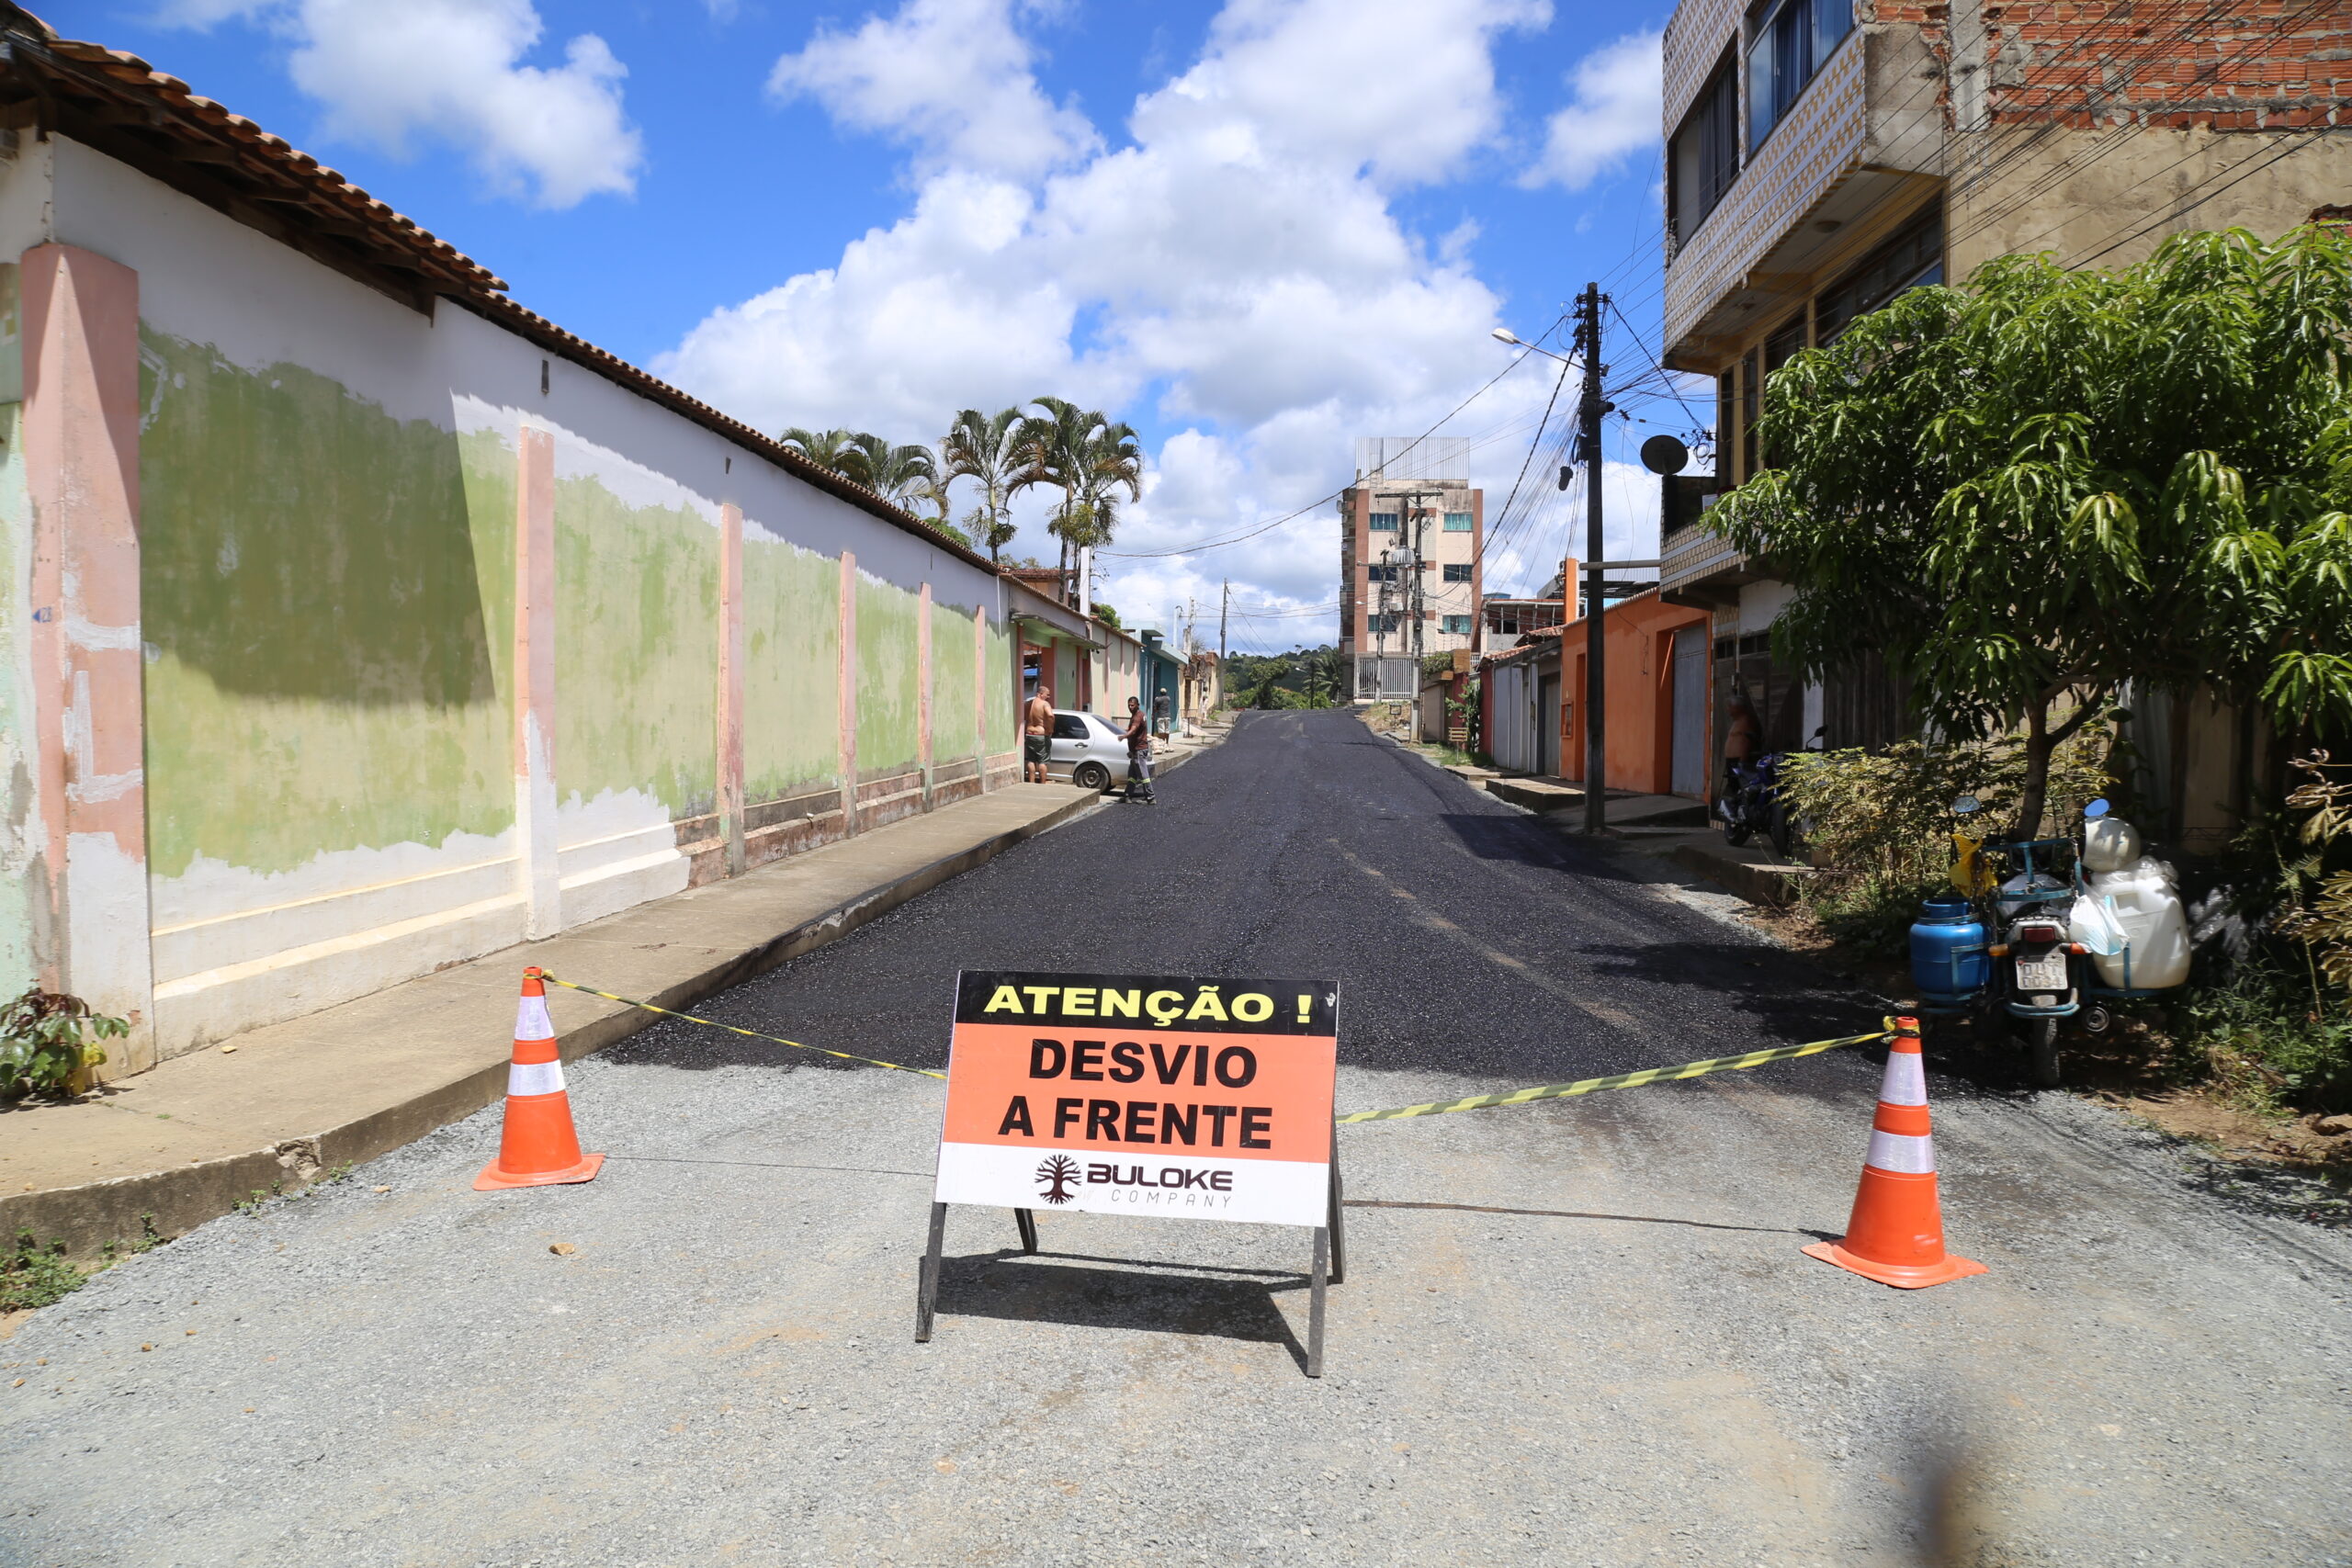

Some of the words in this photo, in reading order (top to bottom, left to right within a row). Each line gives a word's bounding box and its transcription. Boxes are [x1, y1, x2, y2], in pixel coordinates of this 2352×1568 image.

[984, 986, 1274, 1026] ATENÇÃO
[1296, 995, 1312, 1023] !
[1029, 1039, 1257, 1088] DESVIO
[999, 1096, 1035, 1137] A
[1053, 1098, 1272, 1149] FRENTE
[1087, 1163, 1233, 1191] BULOKE
[1112, 1189, 1233, 1209] COMPANY
